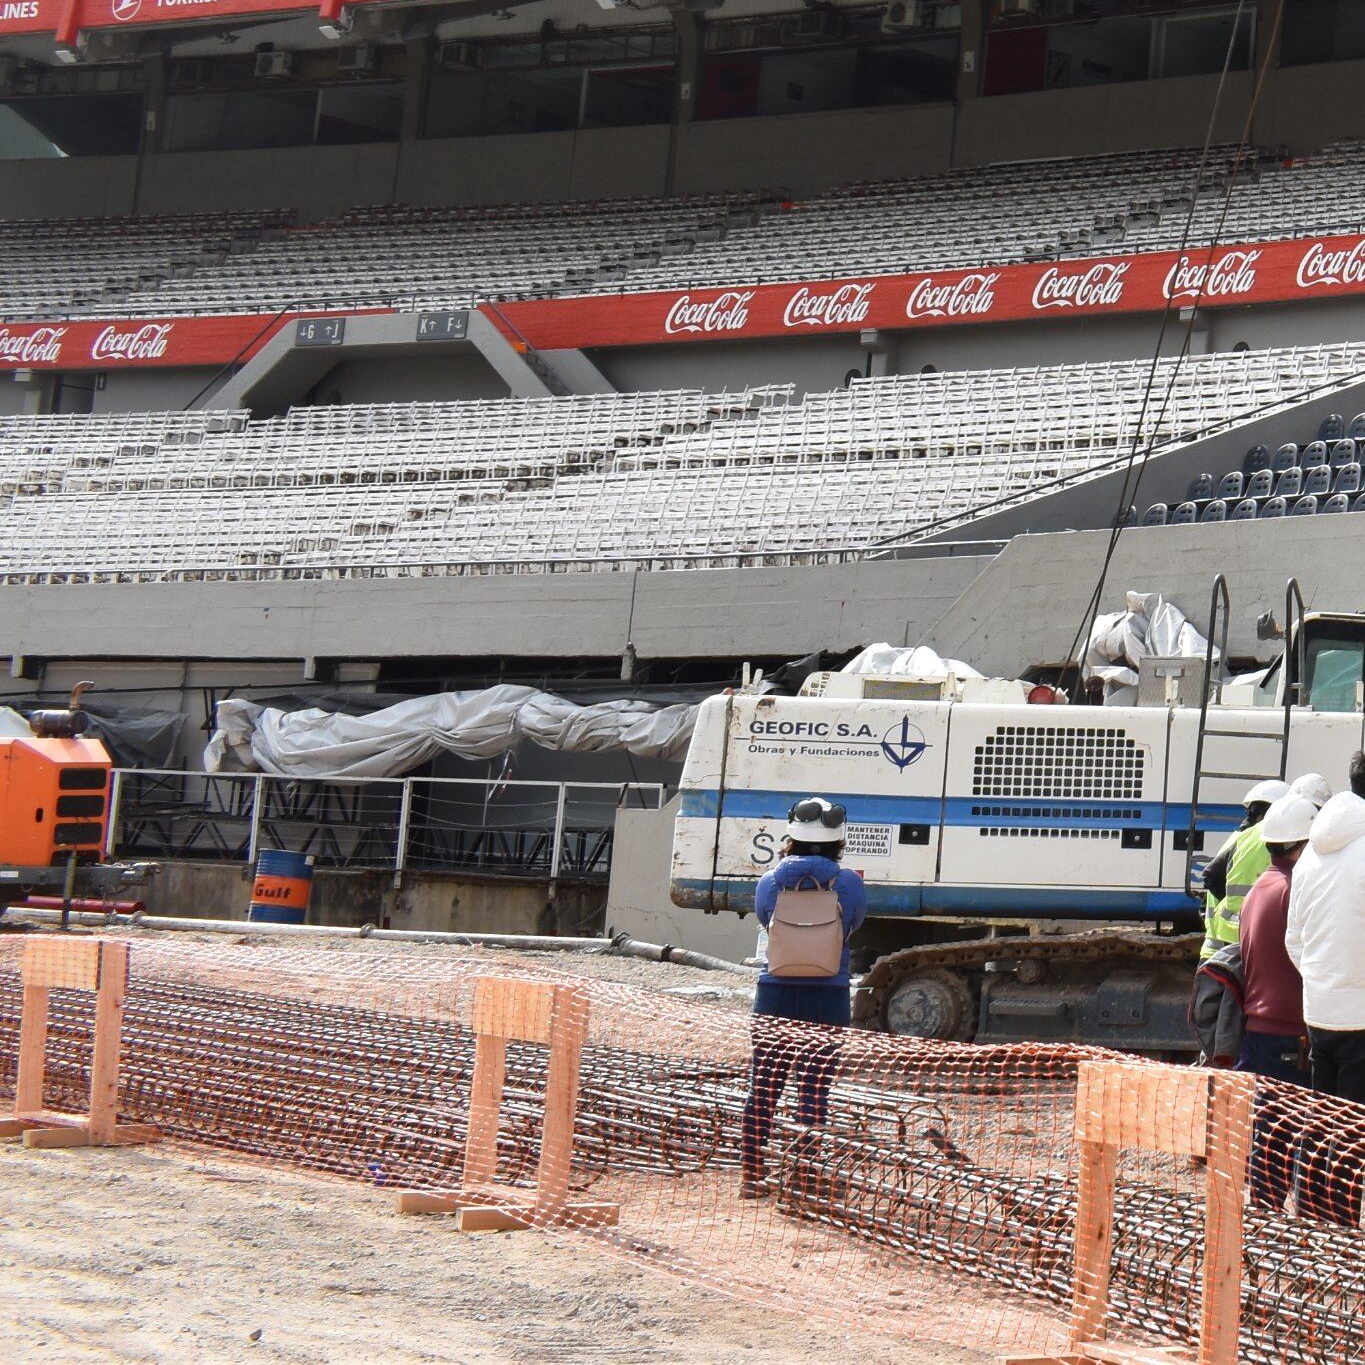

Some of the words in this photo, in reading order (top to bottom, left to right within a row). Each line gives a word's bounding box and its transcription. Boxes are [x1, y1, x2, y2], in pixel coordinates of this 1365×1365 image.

[0, 1, 40, 20] INES
[1162, 249, 1264, 299] Coca-Cola
[1032, 261, 1132, 309] Coca-Cola
[783, 281, 876, 327] Coca-Cola
[906, 272, 1002, 319] Coca-Cola
[665, 291, 755, 334] Coca-Cola
[420, 318, 427, 334] K
[92, 323, 174, 360] Coca-Cola
[750, 720, 829, 736] GEOFIC
[837, 723, 878, 738] S.A.
[748, 745, 785, 754] Obras
[789, 747, 797, 755] y
[800, 746, 880, 757] Fundaciones
[847, 826, 890, 834] MANTENER
[847, 833, 889, 841] DISTANCIA
[845, 847, 889, 855] OPERANDO
[848, 840, 886, 848] MAQUINA
[254, 883, 291, 899] Gulf
